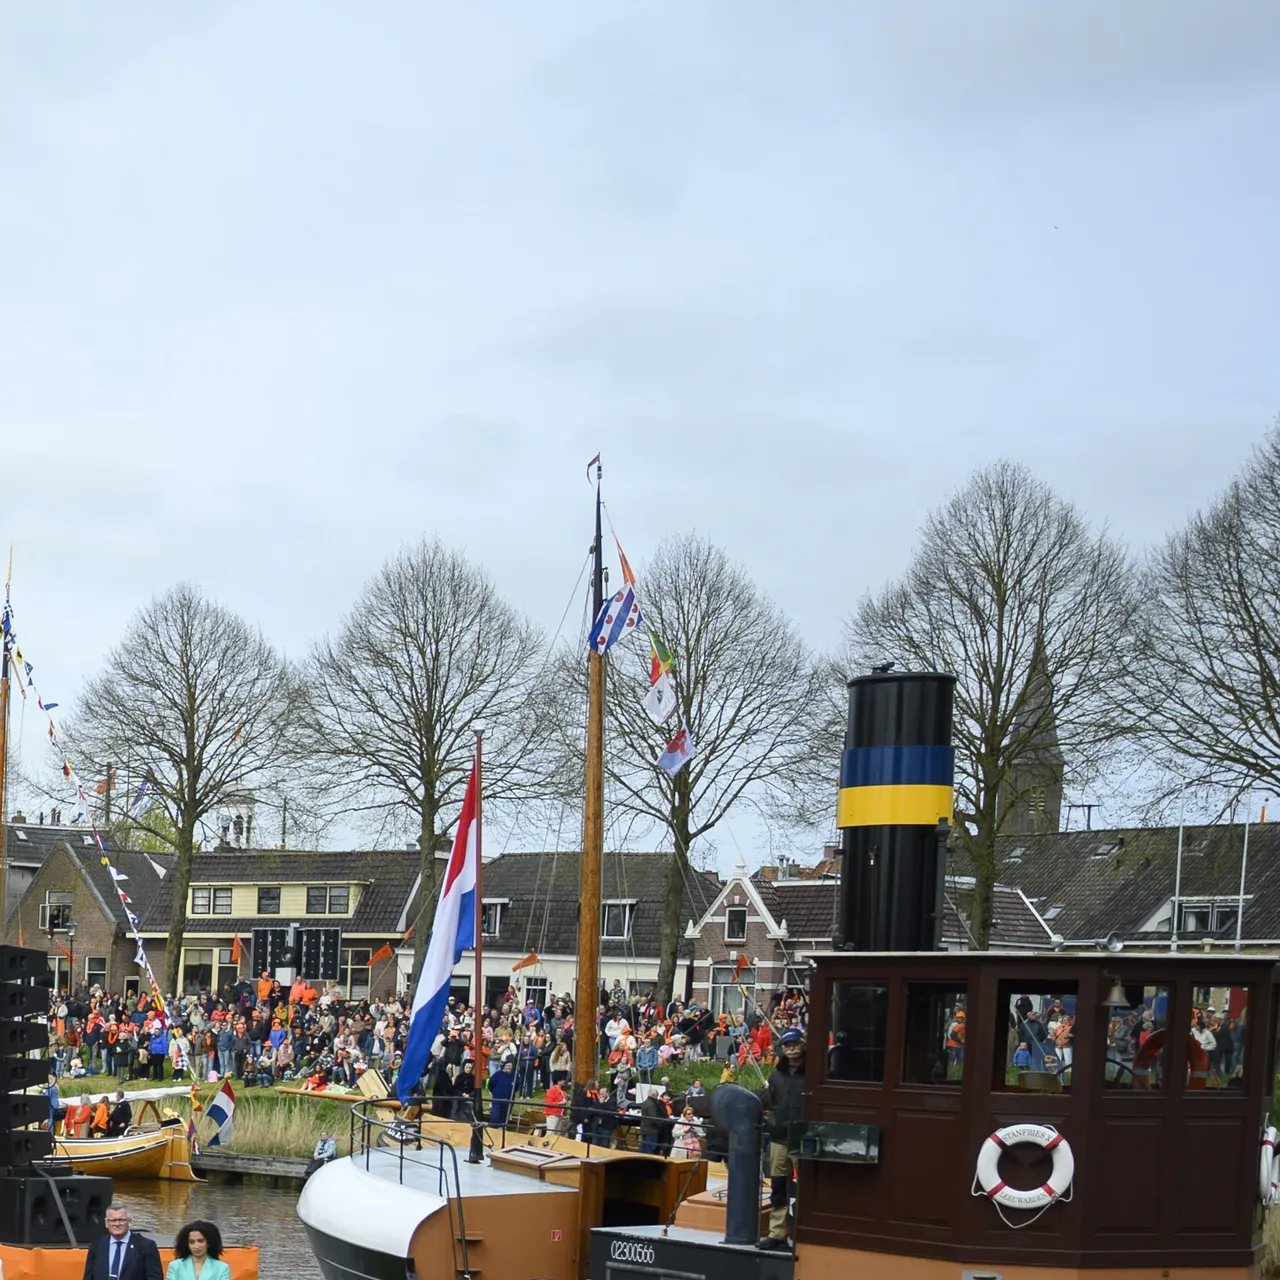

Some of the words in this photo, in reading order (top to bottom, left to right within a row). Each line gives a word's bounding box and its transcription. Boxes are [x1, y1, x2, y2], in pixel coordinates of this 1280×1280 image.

[1002, 1128, 1045, 1142] STANFRIES
[999, 1190, 1048, 1204] LEEUWARDEN
[610, 1240, 655, 1264] 02300566
